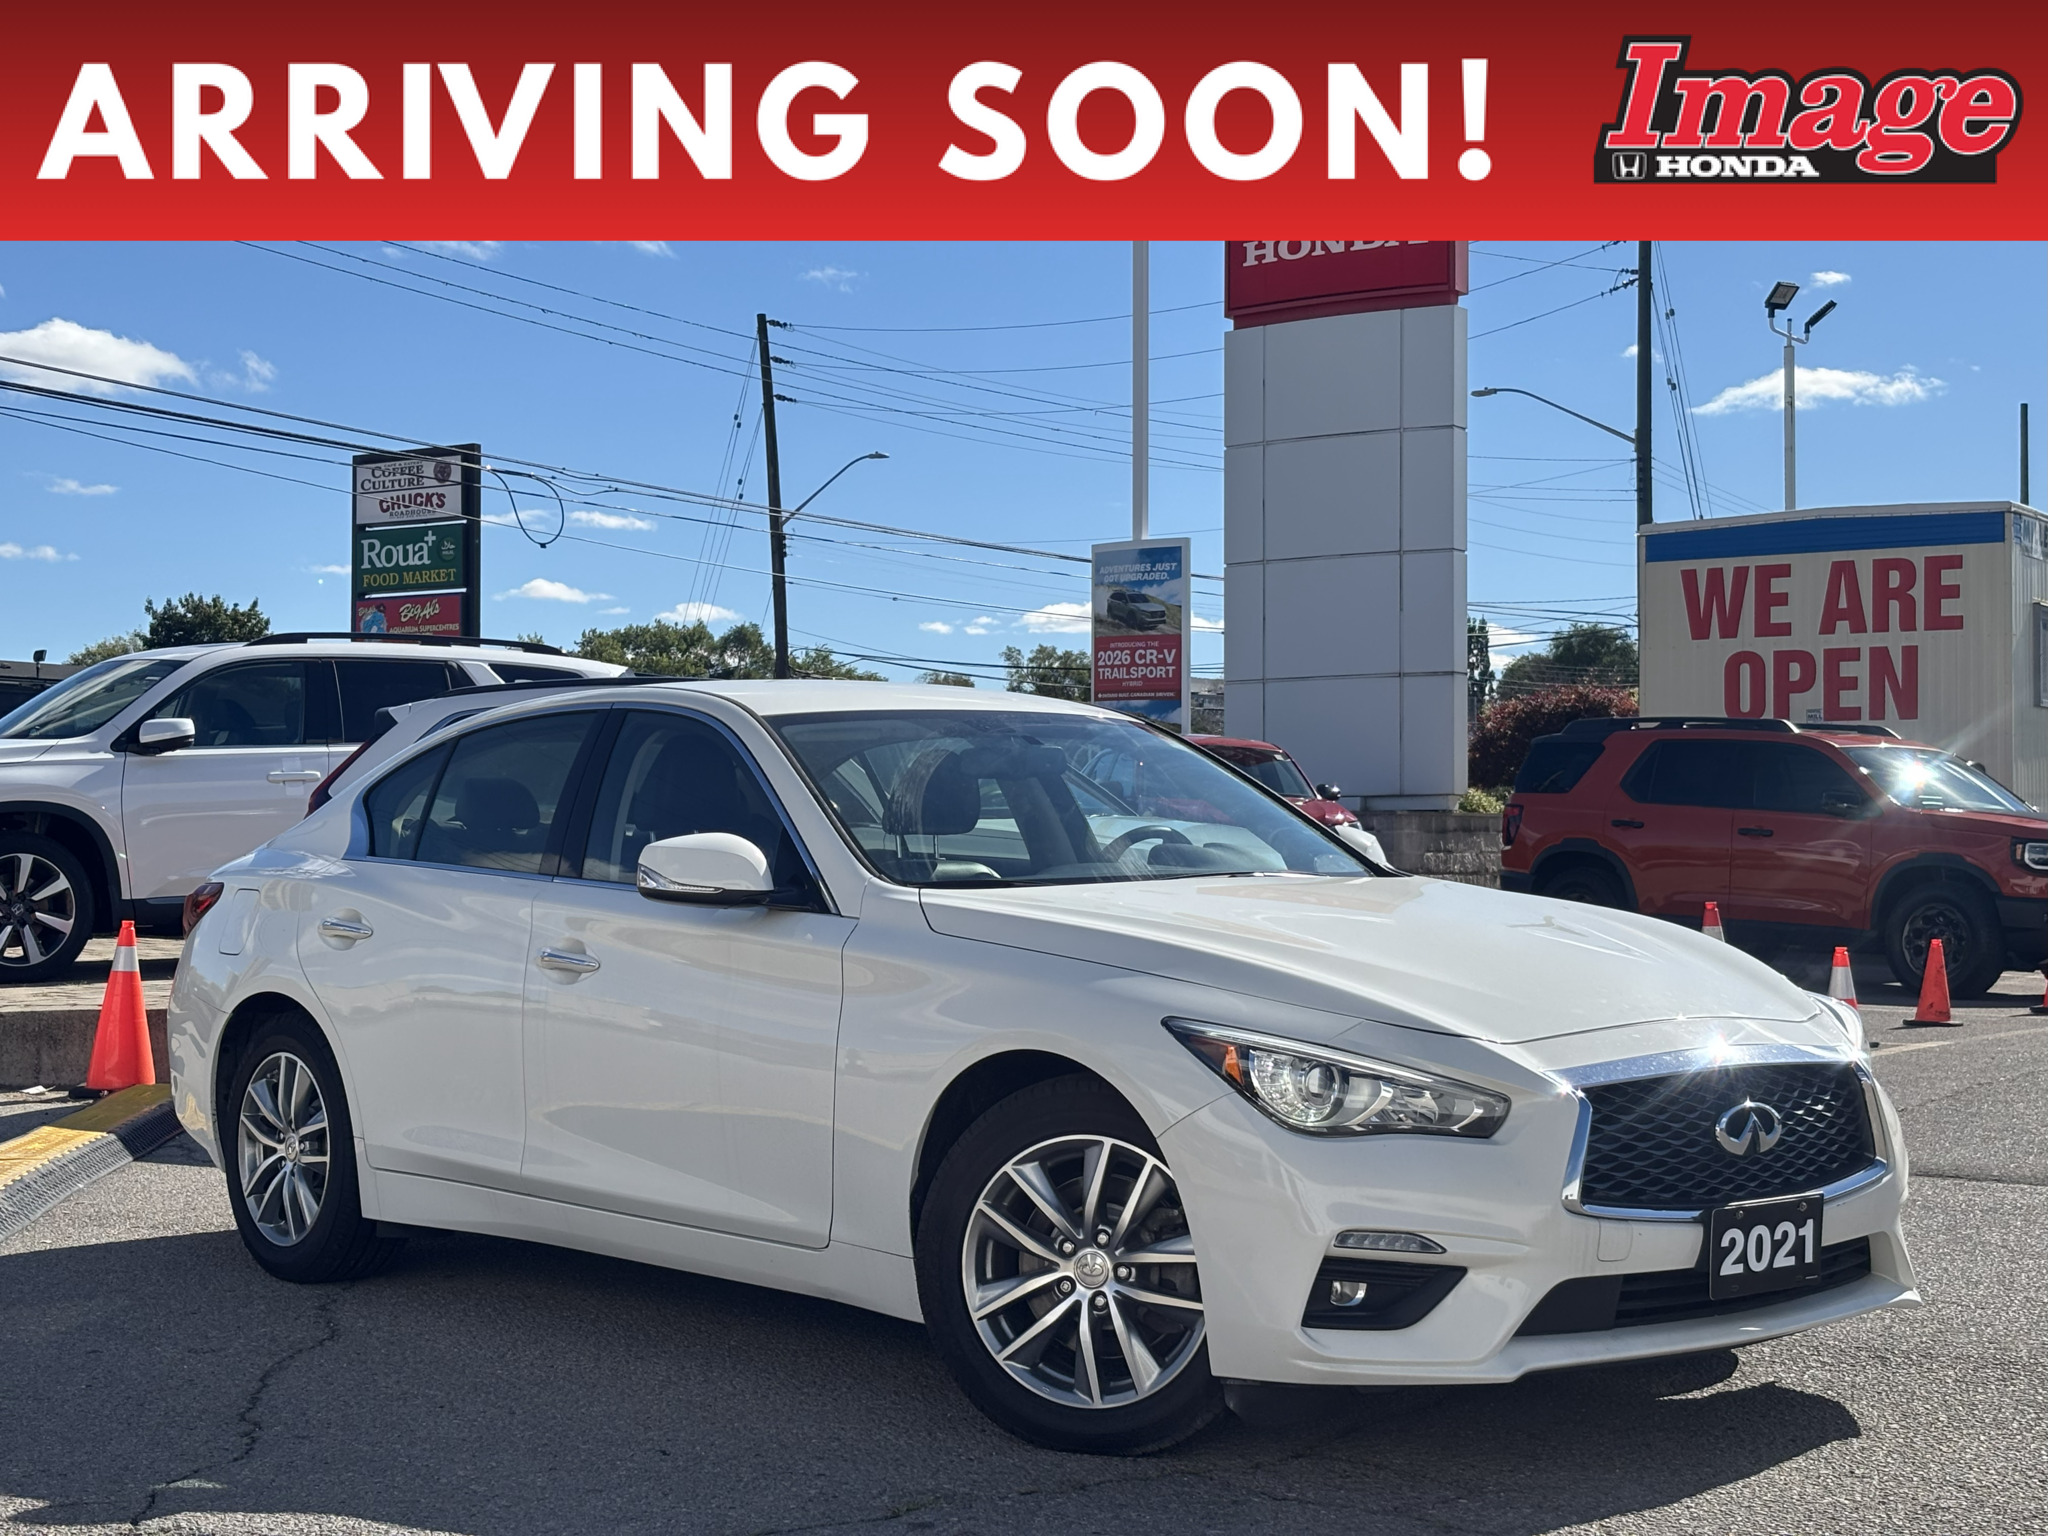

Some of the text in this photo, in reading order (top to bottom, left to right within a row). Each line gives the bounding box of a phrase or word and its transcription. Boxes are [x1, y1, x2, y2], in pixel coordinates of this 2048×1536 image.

[1242, 240, 1429, 267] HON
[371, 465, 425, 479] COFFEE
[361, 477, 425, 491] CULTURE
[379, 492, 446, 513] CHUCK'S
[1100, 562, 1177, 574] ADVENTURES JUST
[363, 568, 456, 587] FOOD MARKET
[1120, 572, 1170, 582] UPGRADED.
[1680, 554, 1964, 641] WE ARE
[389, 625, 419, 634] AQUARIUM
[420, 623, 460, 633] SUPERCENTRES
[1097, 649, 1177, 666] 2026 CR-V
[1097, 666, 1176, 680] TRAILSPORT
[1724, 645, 1919, 720] OPEN
[1719, 1218, 1814, 1276] 2021
